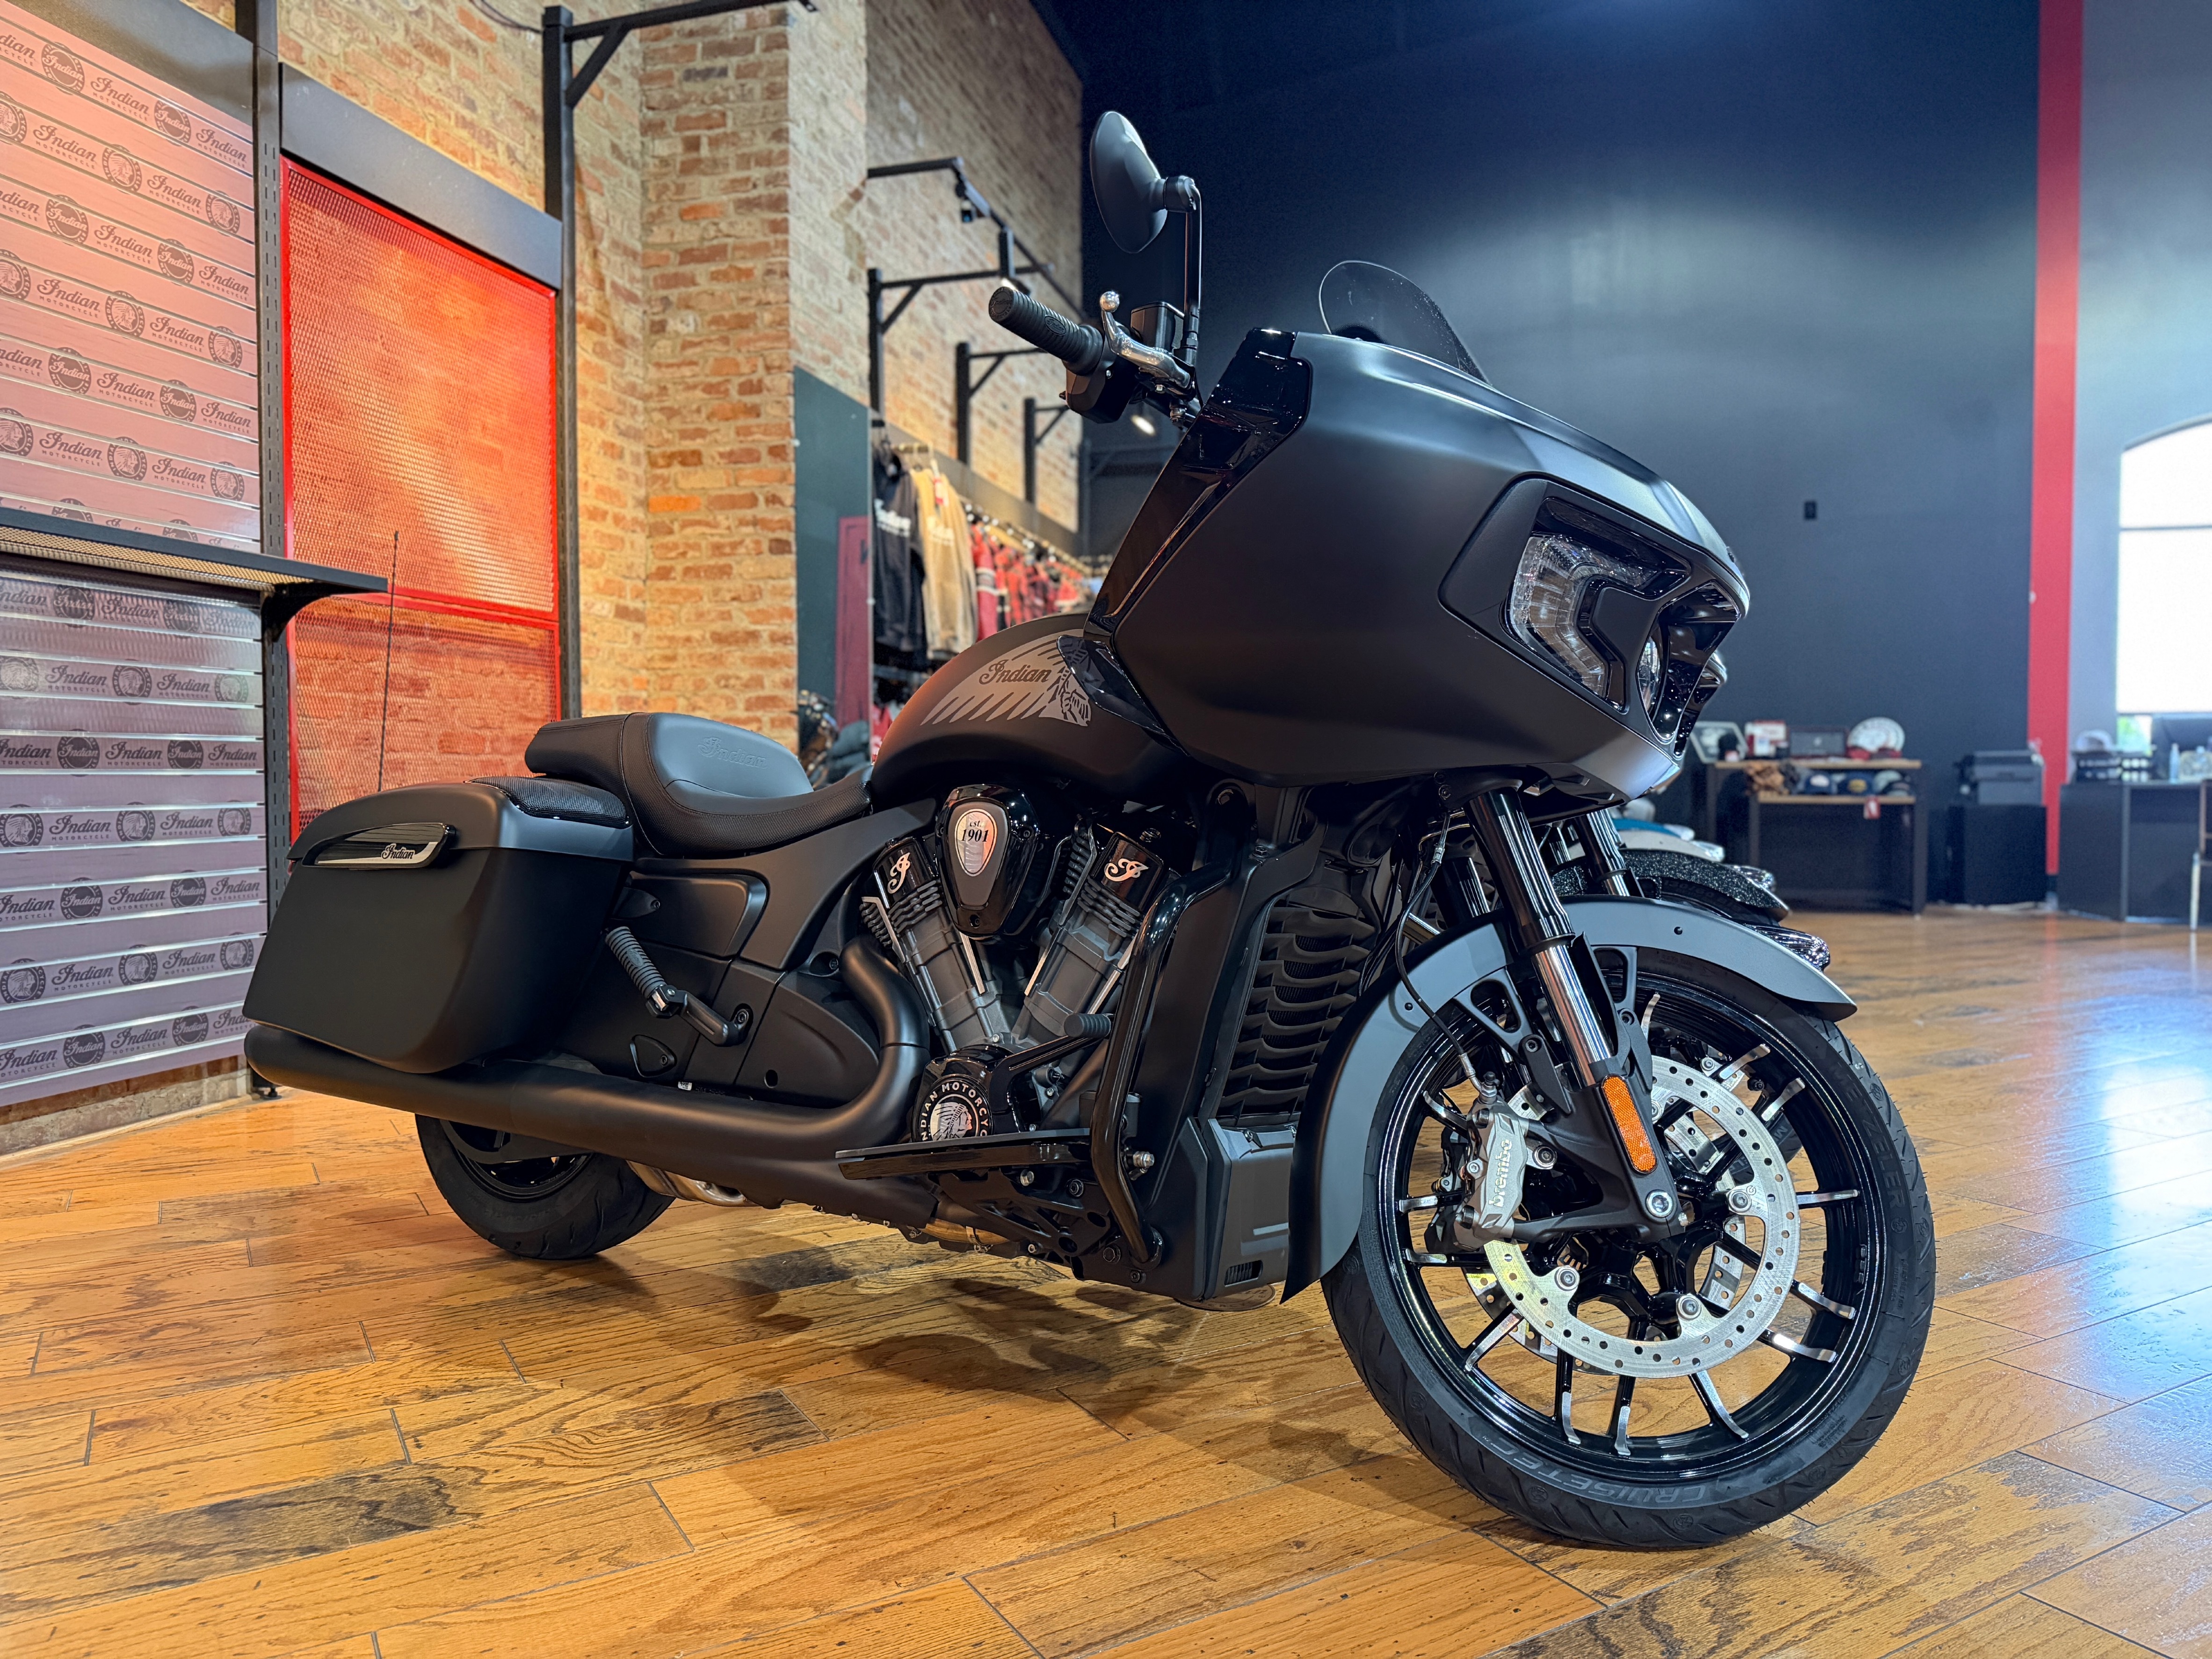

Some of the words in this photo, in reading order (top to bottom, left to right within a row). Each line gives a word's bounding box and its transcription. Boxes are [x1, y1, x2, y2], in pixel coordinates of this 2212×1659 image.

[0, 35, 36, 58] dian
[0, 49, 33, 66] CYCLE
[42, 54, 84, 80] Indian
[91, 77, 149, 115] Indian
[93, 92, 147, 121] MOTORCYCLE
[155, 110, 190, 132] Indian
[33, 124, 96, 162] Indian
[196, 129, 247, 161] Indian
[36, 140, 94, 169] MOTORCYCLE
[198, 143, 245, 168] MOTORCYCLE
[0, 190, 39, 213] dian
[147, 175, 201, 207] Indian
[2, 205, 37, 221] RCYCLE
[150, 190, 200, 215] MOTORCYCLE
[48, 208, 87, 231] Indian
[94, 225, 152, 257] Indian
[97, 241, 151, 264] MOTORCYCLE
[159, 252, 193, 271] Indian
[199, 266, 249, 294] Indian
[201, 280, 247, 301] MOTORCYCLE
[37, 279, 100, 311] Indian
[40, 296, 98, 318] MOTORCYCLE
[150, 317, 204, 346] Indian
[152, 333, 202, 352] MOTORCYCLE
[0, 349, 42, 370] ndian
[50, 361, 90, 381] Indian
[97, 373, 155, 400] Indian
[99, 389, 153, 407] MOTORCYCLE
[161, 393, 195, 410] Indian
[201, 401, 251, 428] Indian
[203, 418, 249, 434] MOTORCYCLE
[39, 432, 102, 459] Indian
[42, 450, 100, 467] MOTORCYCLE
[152, 458, 206, 483] Indian
[154, 475, 204, 489] MOTORCYCLE
[0, 590, 47, 606] ndian
[102, 597, 158, 619] Indian
[45, 665, 107, 685] Indian
[157, 673, 210, 692] Indian
[979, 660, 1052, 684] Indian
[58, 744, 98, 757] Indian
[105, 742, 162, 759] Indian
[208, 744, 257, 760] Indian
[697, 736, 768, 769] Indian
[49, 815, 111, 834] Indian
[160, 812, 213, 830] Indian
[960, 829, 989, 843] 1901
[381, 843, 415, 859] Indian
[108, 885, 165, 905] Indian
[211, 877, 260, 895] Indian
[61, 894, 101, 907] Indian
[163, 950, 215, 969] Indian
[51, 964, 113, 985] Indian
[55, 980, 112, 991] MOTORCYCLE
[111, 1027, 167, 1048] Indian
[113, 1041, 165, 1055] MOTORCYCLE
[64, 1041, 103, 1056] Indian
[0, 1062, 55, 1077] OTORCYCLE
[921, 1091, 938, 1141] NDIAN
[942, 1082, 988, 1136] MOTORCYC
[1831, 1061, 1905, 1209] METZELER
[1489, 1139, 1512, 1208] brembo
[1490, 1438, 1706, 1504] CRUISETEC
